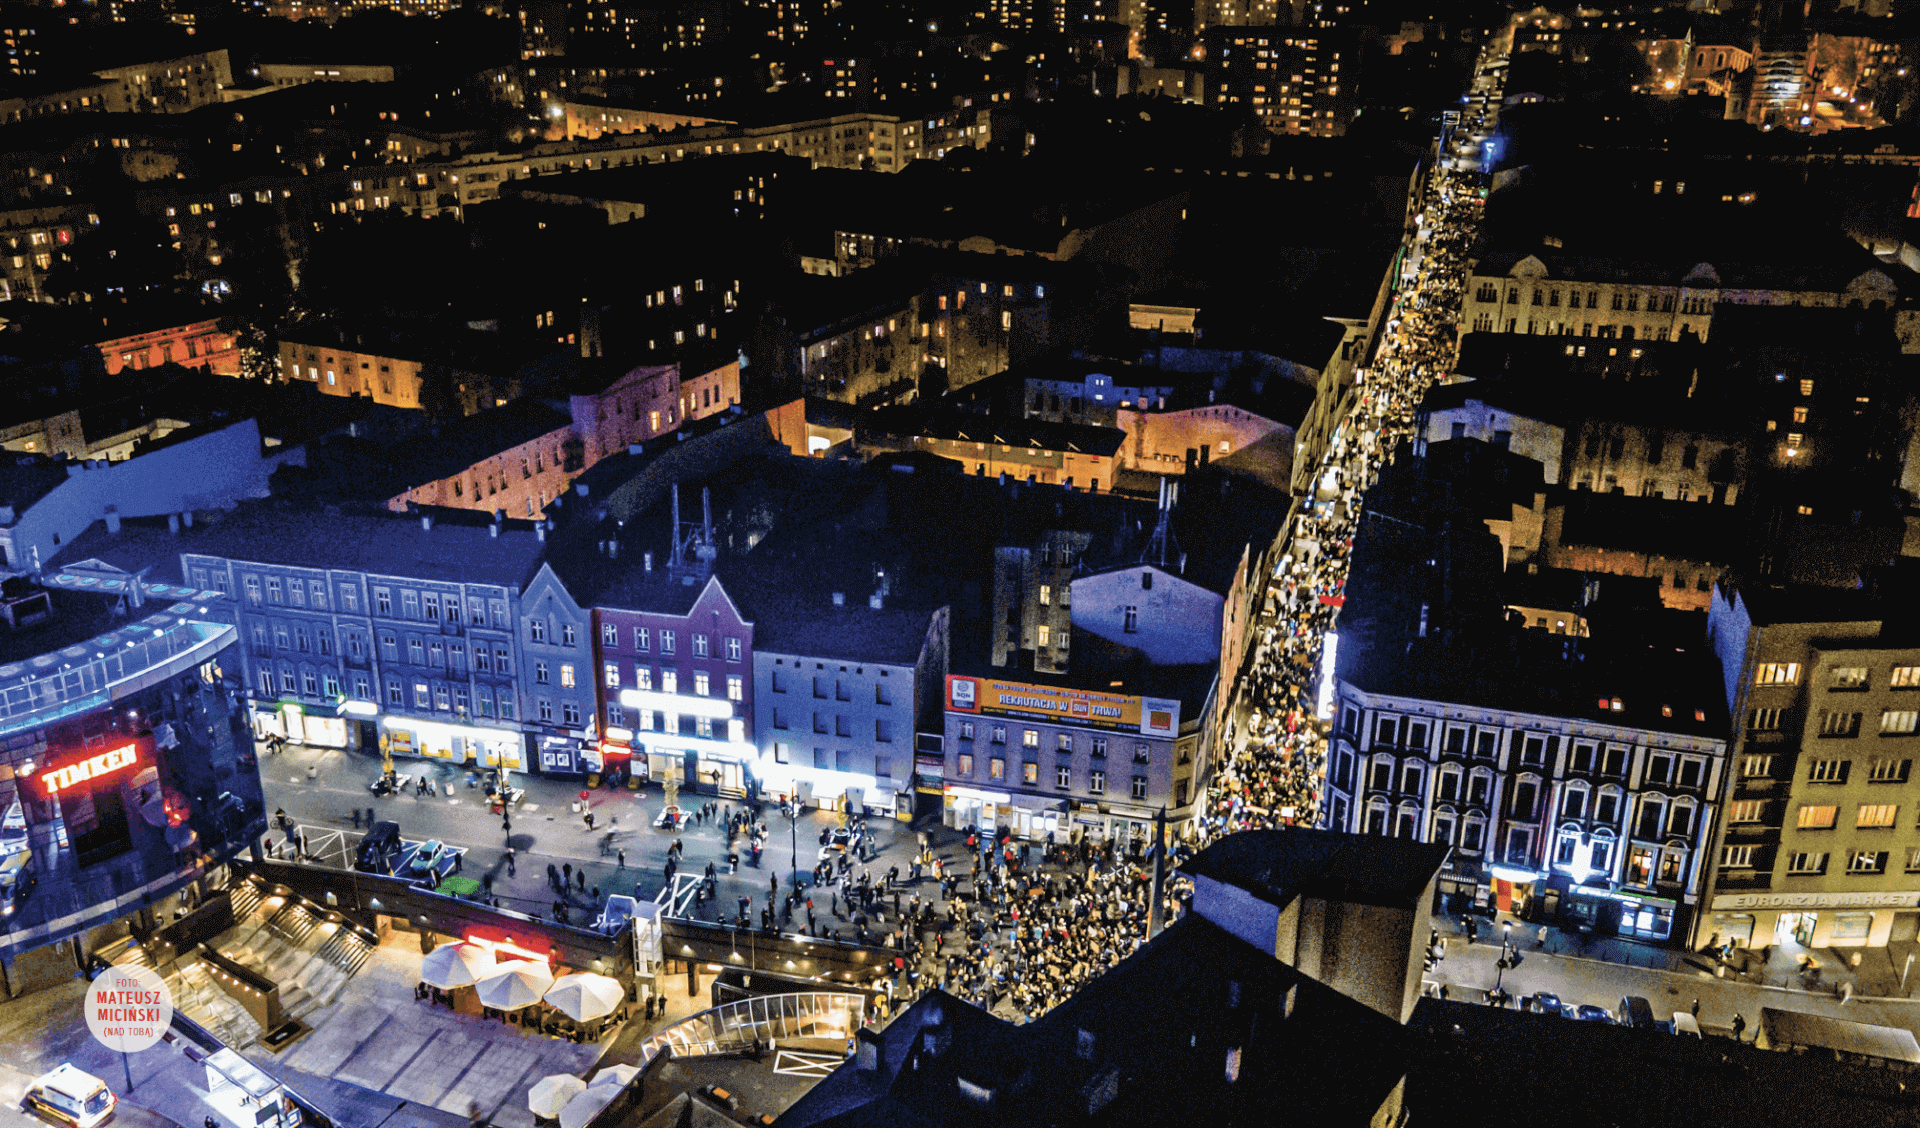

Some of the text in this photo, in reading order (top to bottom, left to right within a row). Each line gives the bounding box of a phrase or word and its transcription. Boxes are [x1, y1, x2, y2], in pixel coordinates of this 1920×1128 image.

[999, 694, 1058, 711] REKRUTACJA
[1058, 701, 1069, 712] W
[1091, 704, 1122, 718] TRWA!
[41, 743, 138, 793] TIMKEN
[1735, 894, 1912, 907] EUROAZJA MARKET
